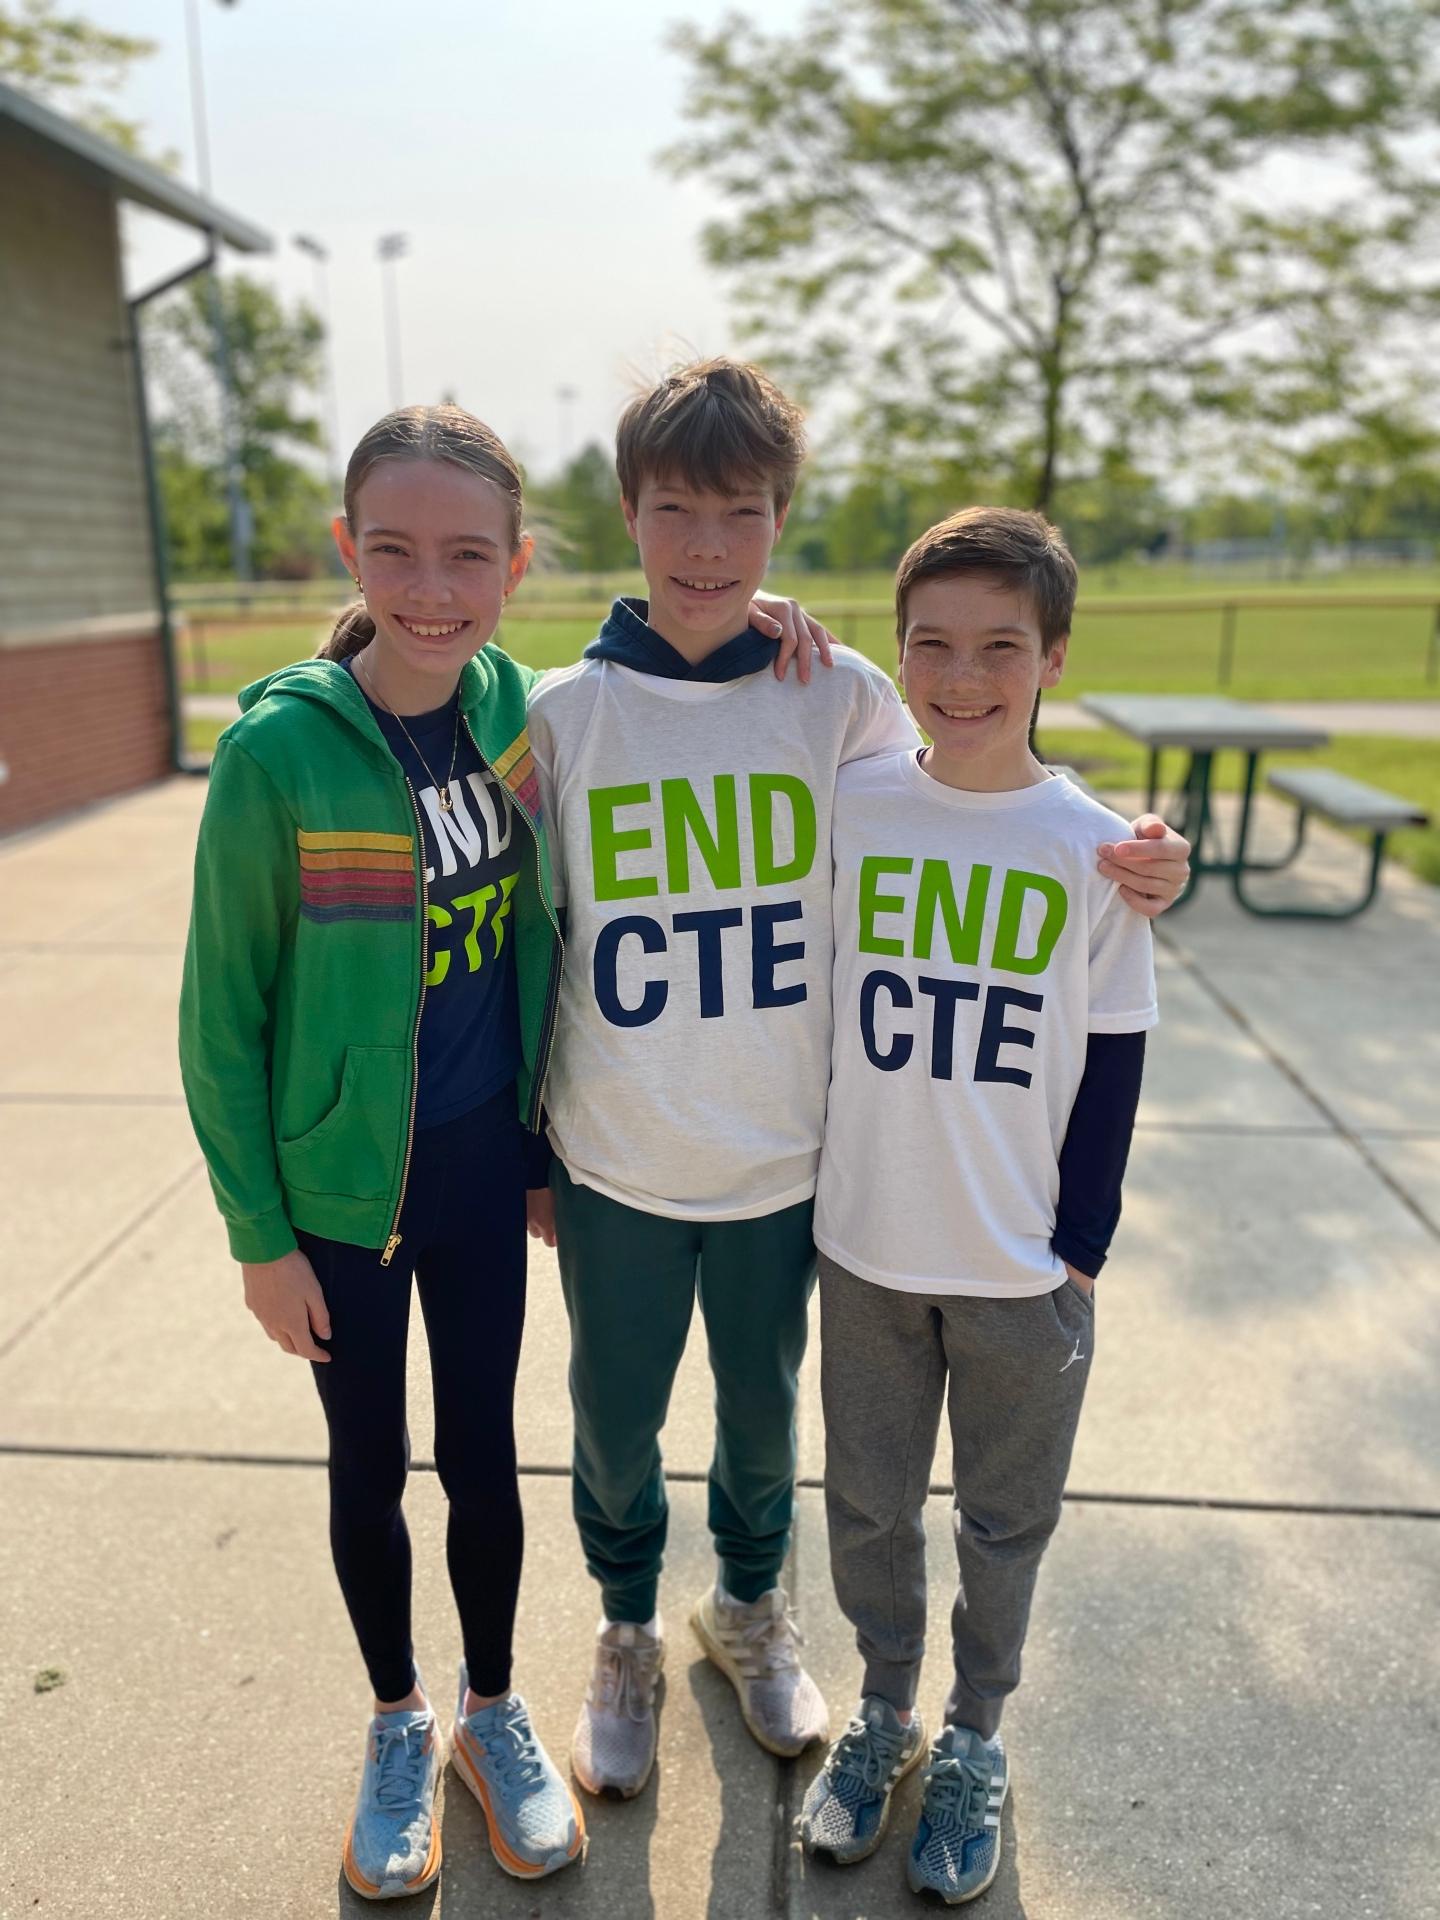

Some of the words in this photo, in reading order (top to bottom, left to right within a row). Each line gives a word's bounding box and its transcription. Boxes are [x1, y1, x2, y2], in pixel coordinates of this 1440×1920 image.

[418, 770, 513, 883] ND
[588, 773, 817, 902] END
[594, 900, 807, 1027] CTE
[859, 856, 1068, 975] END
[860, 970, 1044, 1089] CTE
